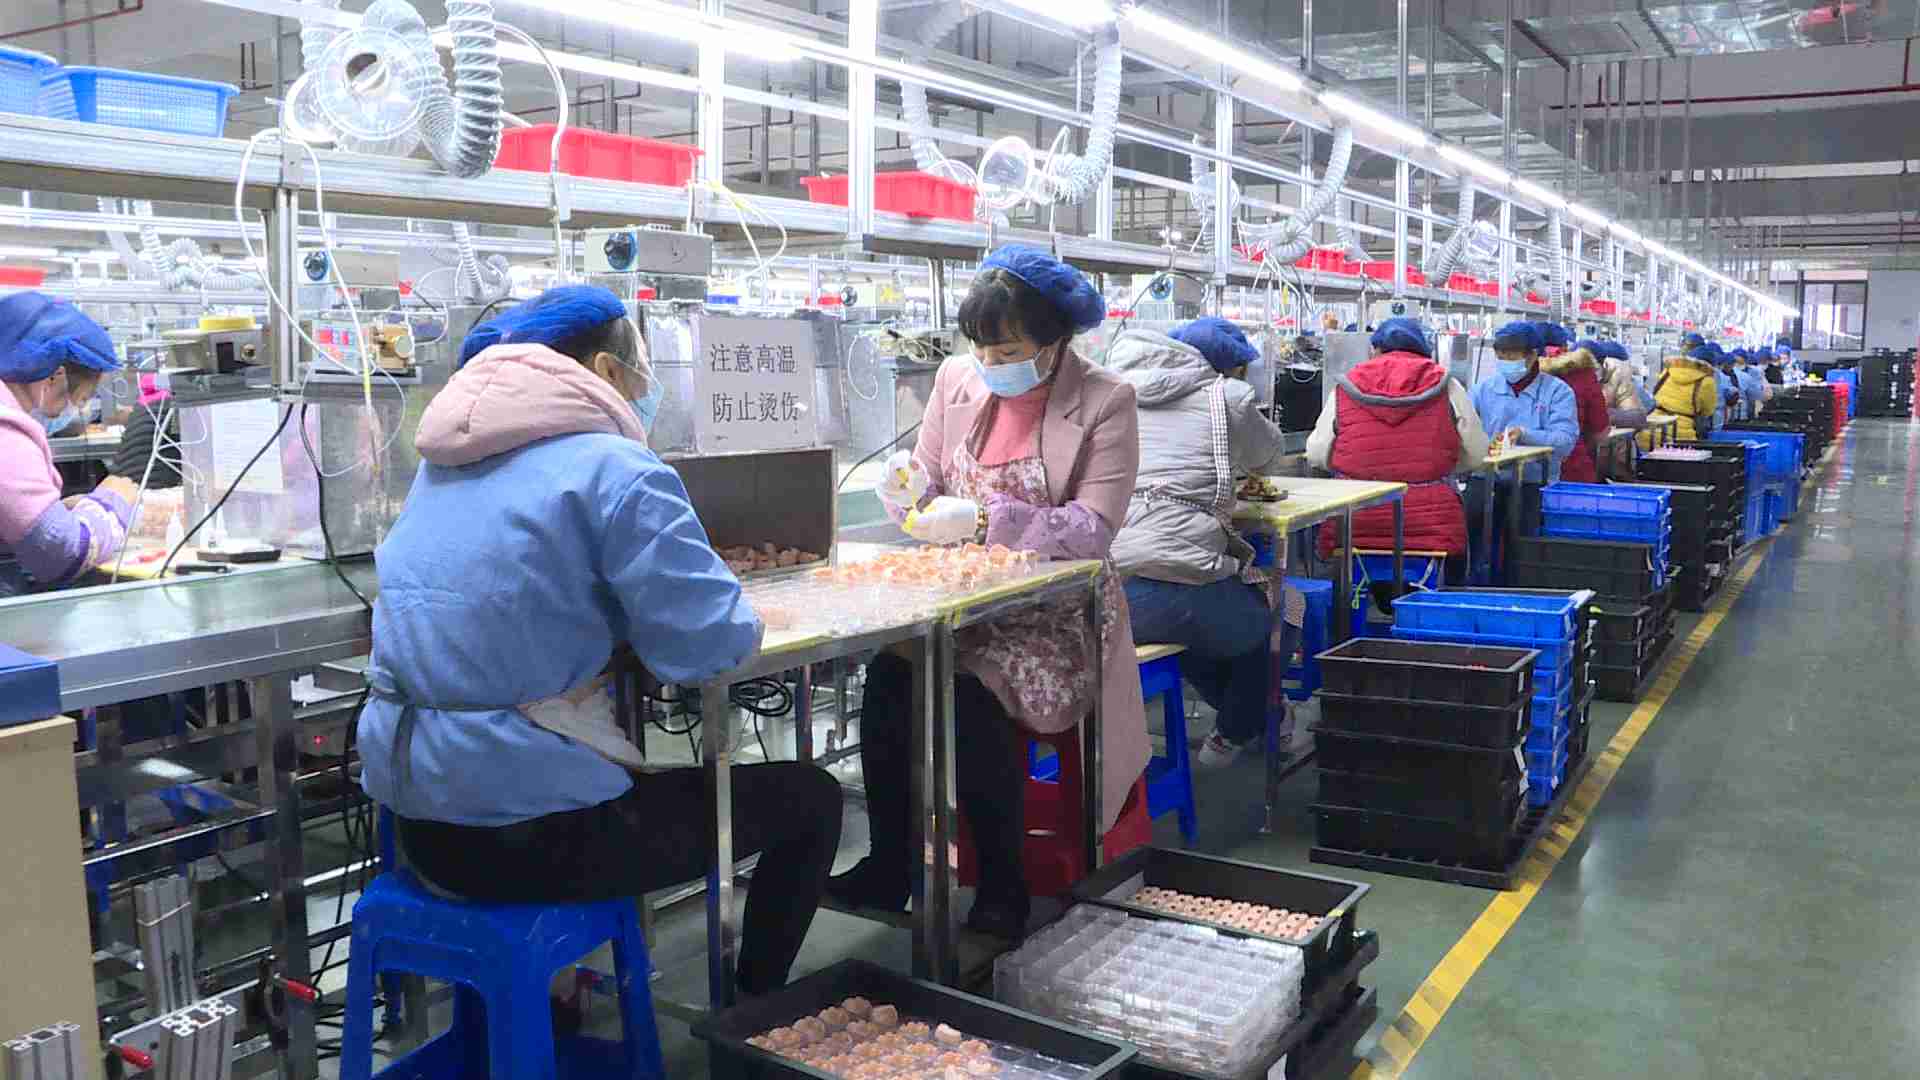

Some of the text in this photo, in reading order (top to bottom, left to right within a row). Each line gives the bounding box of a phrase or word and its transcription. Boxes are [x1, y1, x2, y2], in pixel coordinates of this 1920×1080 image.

[710, 343, 797, 373] 注意高温
[712, 391, 800, 423] 防止烫伤
